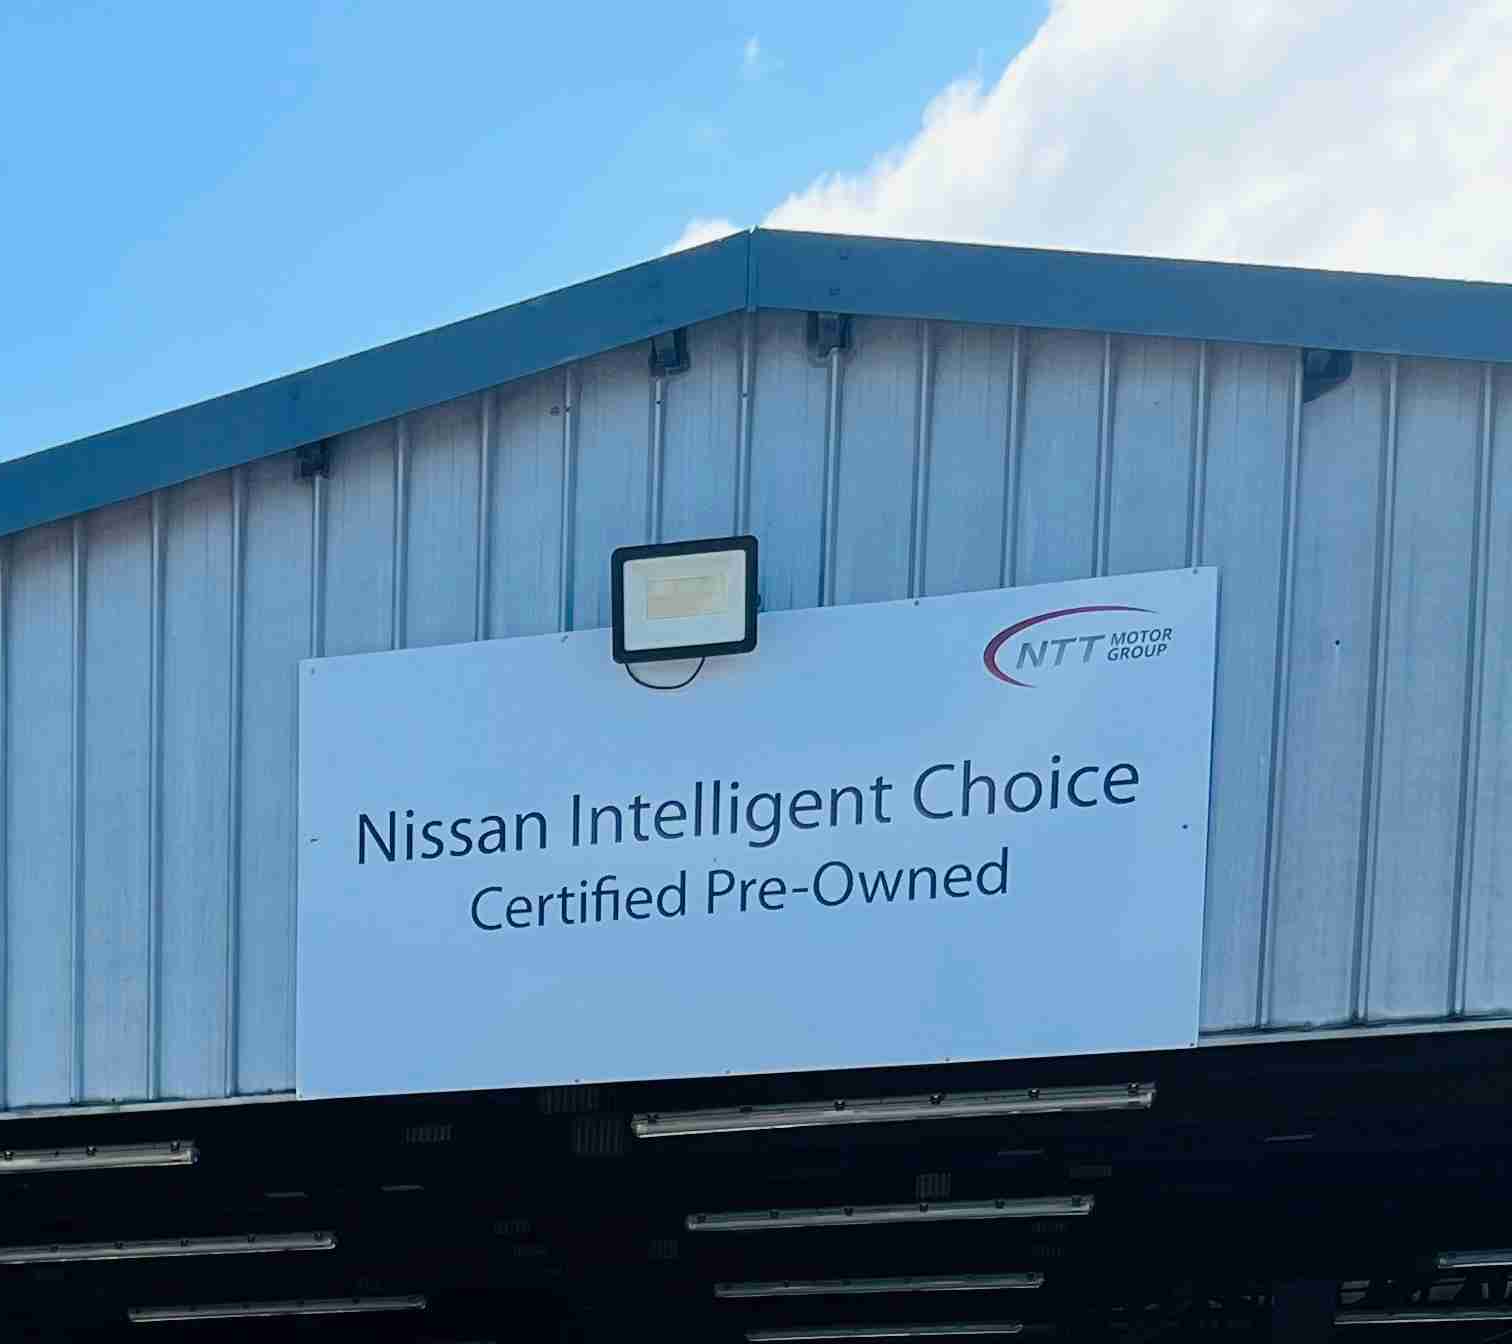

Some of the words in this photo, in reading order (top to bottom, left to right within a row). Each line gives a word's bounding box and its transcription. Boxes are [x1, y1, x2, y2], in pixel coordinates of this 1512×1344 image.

[1015, 634, 1106, 670] NTT
[1107, 643, 1168, 662] GROUP
[1110, 628, 1173, 646] MOTOR
[358, 809, 547, 864] Nissan
[572, 775, 893, 848] Intelligent
[913, 754, 1139, 819] Choice
[471, 870, 687, 930] Certified
[707, 846, 1009, 914] Pre-Owned
